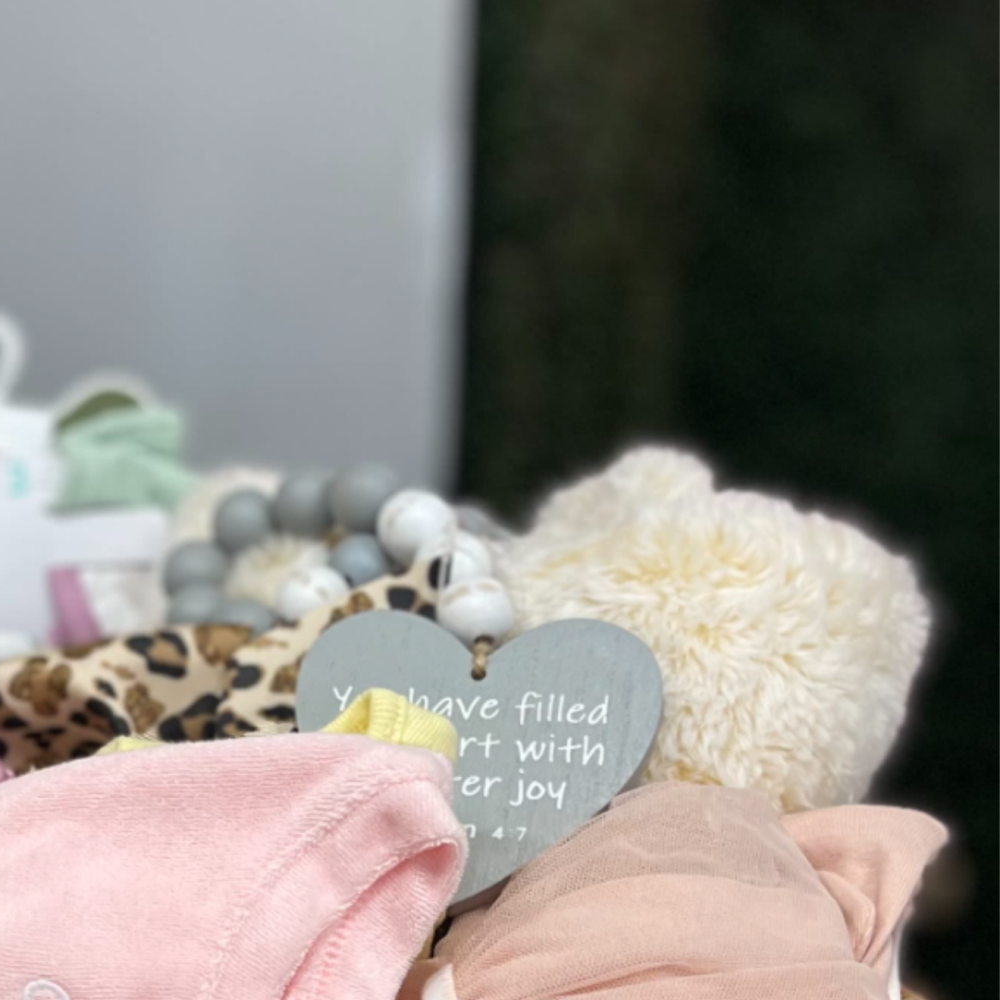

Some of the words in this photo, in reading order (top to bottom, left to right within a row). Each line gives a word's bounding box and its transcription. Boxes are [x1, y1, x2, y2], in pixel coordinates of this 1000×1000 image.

[514, 691, 609, 726] filled
[514, 733, 605, 766] with
[509, 767, 567, 810] joy
